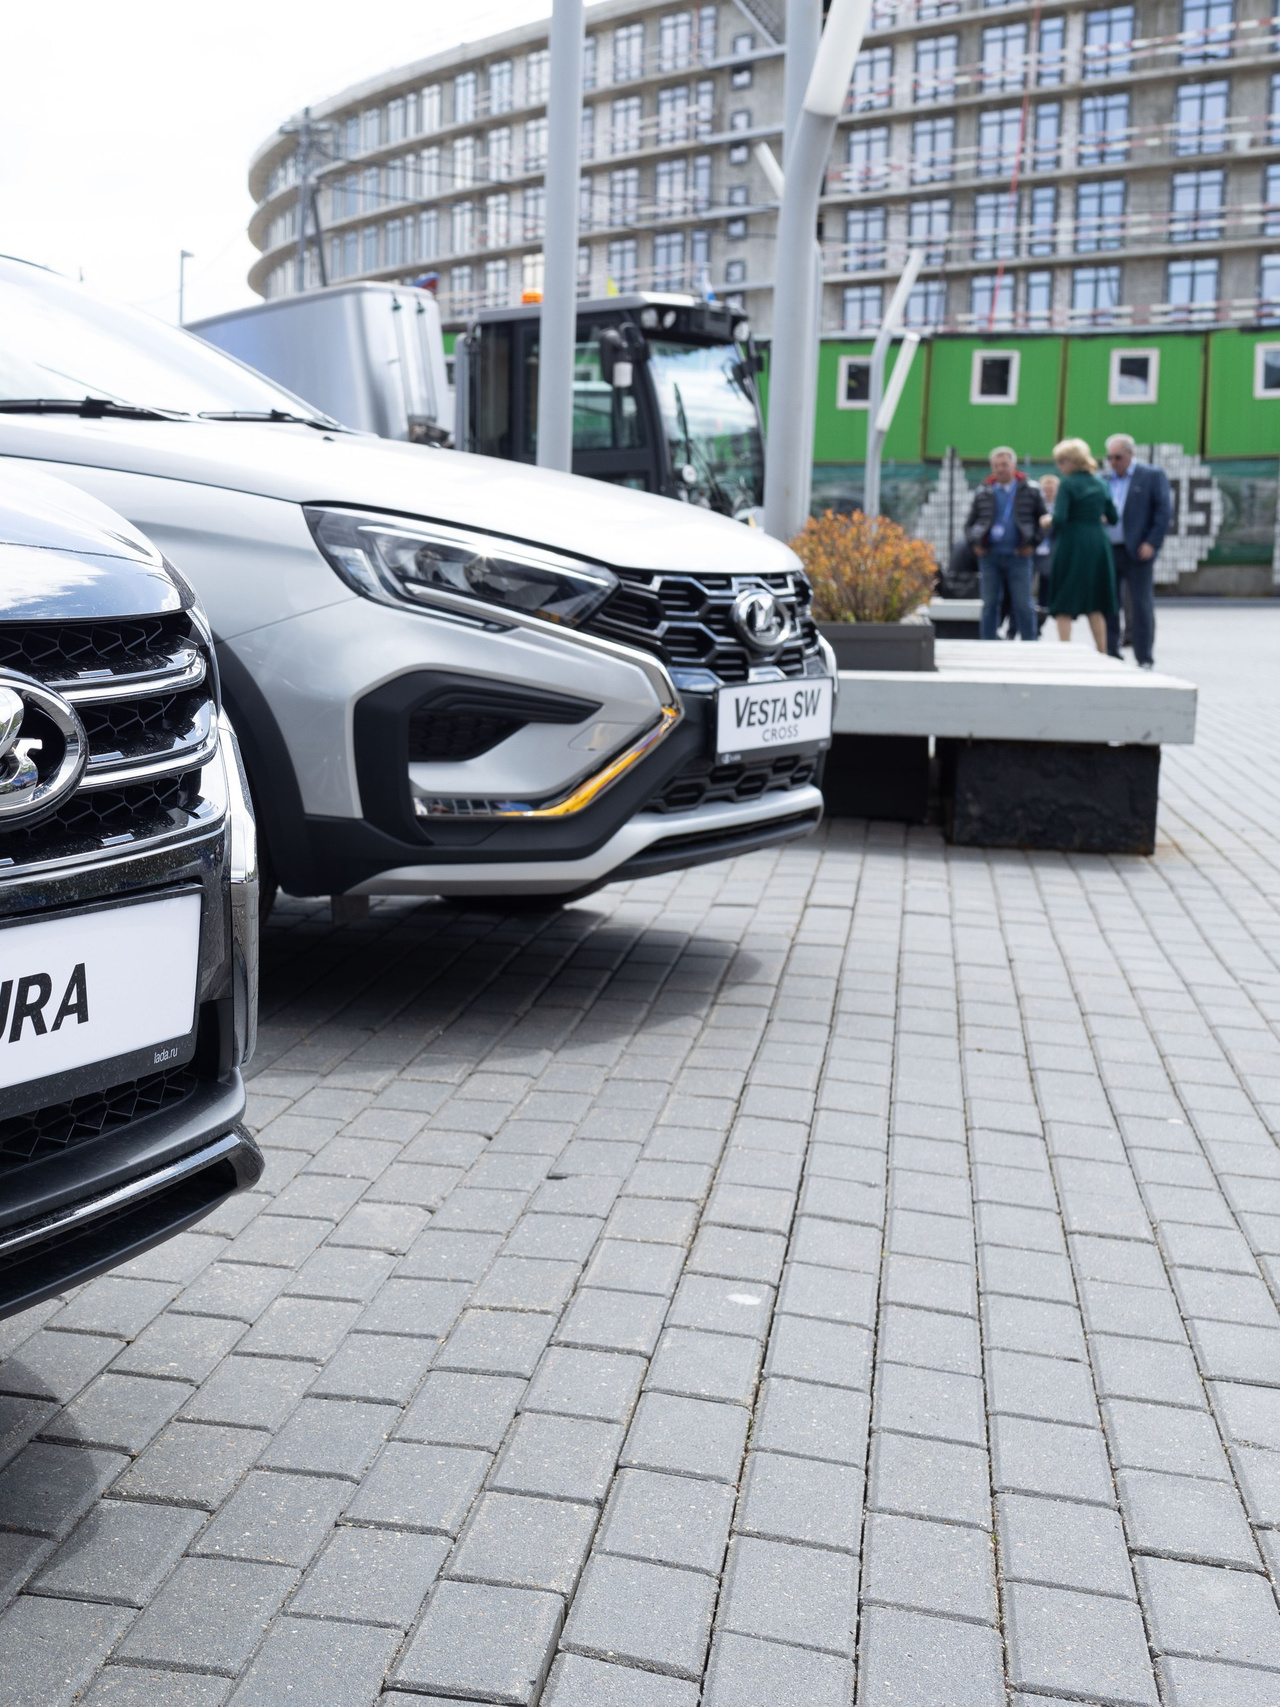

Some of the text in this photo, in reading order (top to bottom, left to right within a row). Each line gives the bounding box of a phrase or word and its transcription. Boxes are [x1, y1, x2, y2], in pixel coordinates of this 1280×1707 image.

[735, 688, 821, 728] VESTA SW
[762, 724, 799, 742] CROSS
[153, 1047, 179, 1064] lada.ru
